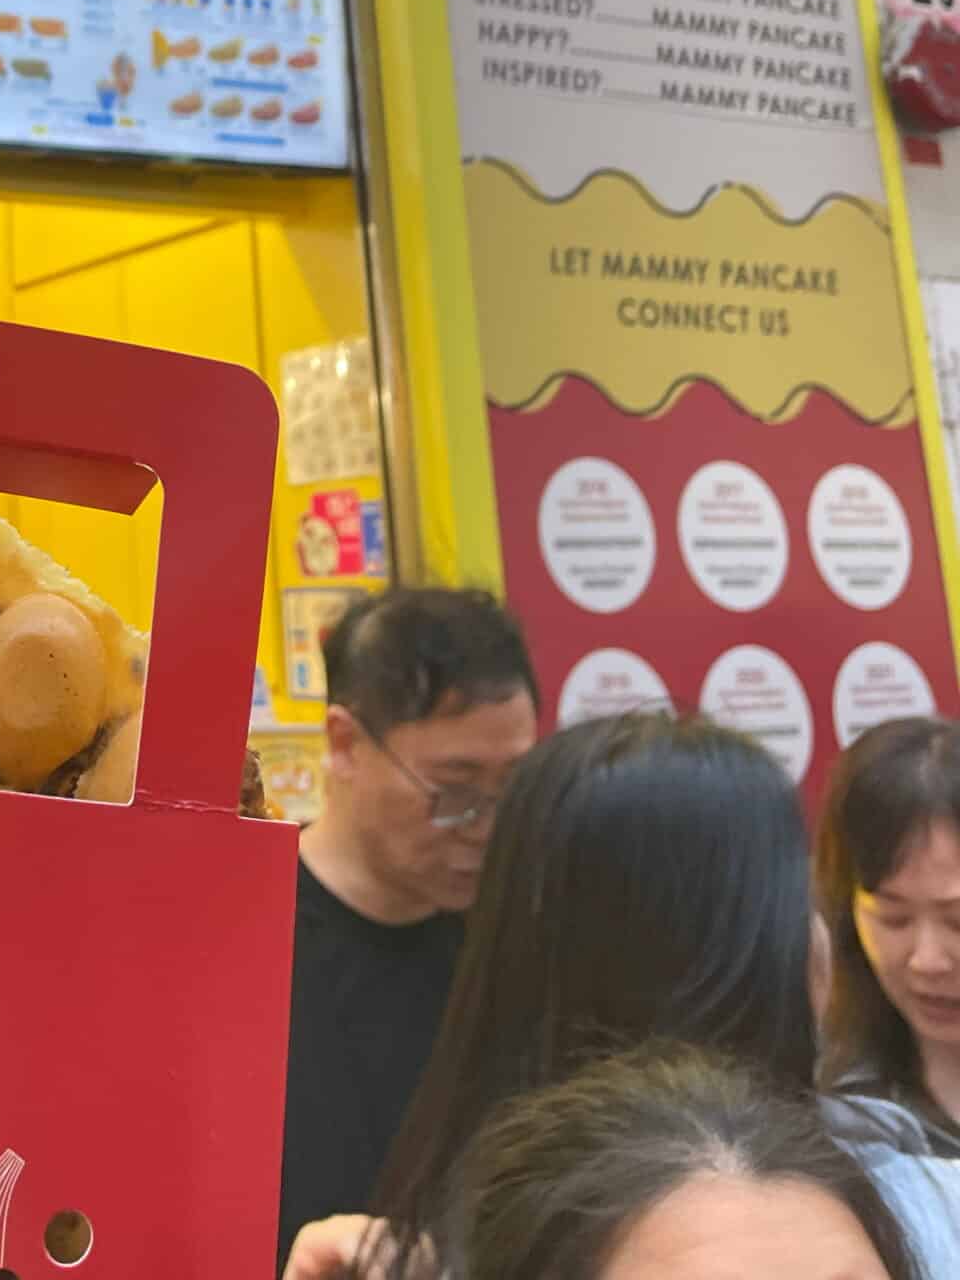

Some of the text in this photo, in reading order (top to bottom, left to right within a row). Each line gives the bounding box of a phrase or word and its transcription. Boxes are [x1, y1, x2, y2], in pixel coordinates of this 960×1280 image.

[478, 19, 850, 92] HAPPY? MAMMY PANCAKE
[652, 6, 740, 39] MAMMY
[748, 19, 845, 56] PANCAKE
[483, 56, 856, 128] INSPIRED? MAMMY PANCAKE
[549, 245, 839, 296] LET MAMMY PANCAKE
[616, 297, 790, 337] CONNECT US
